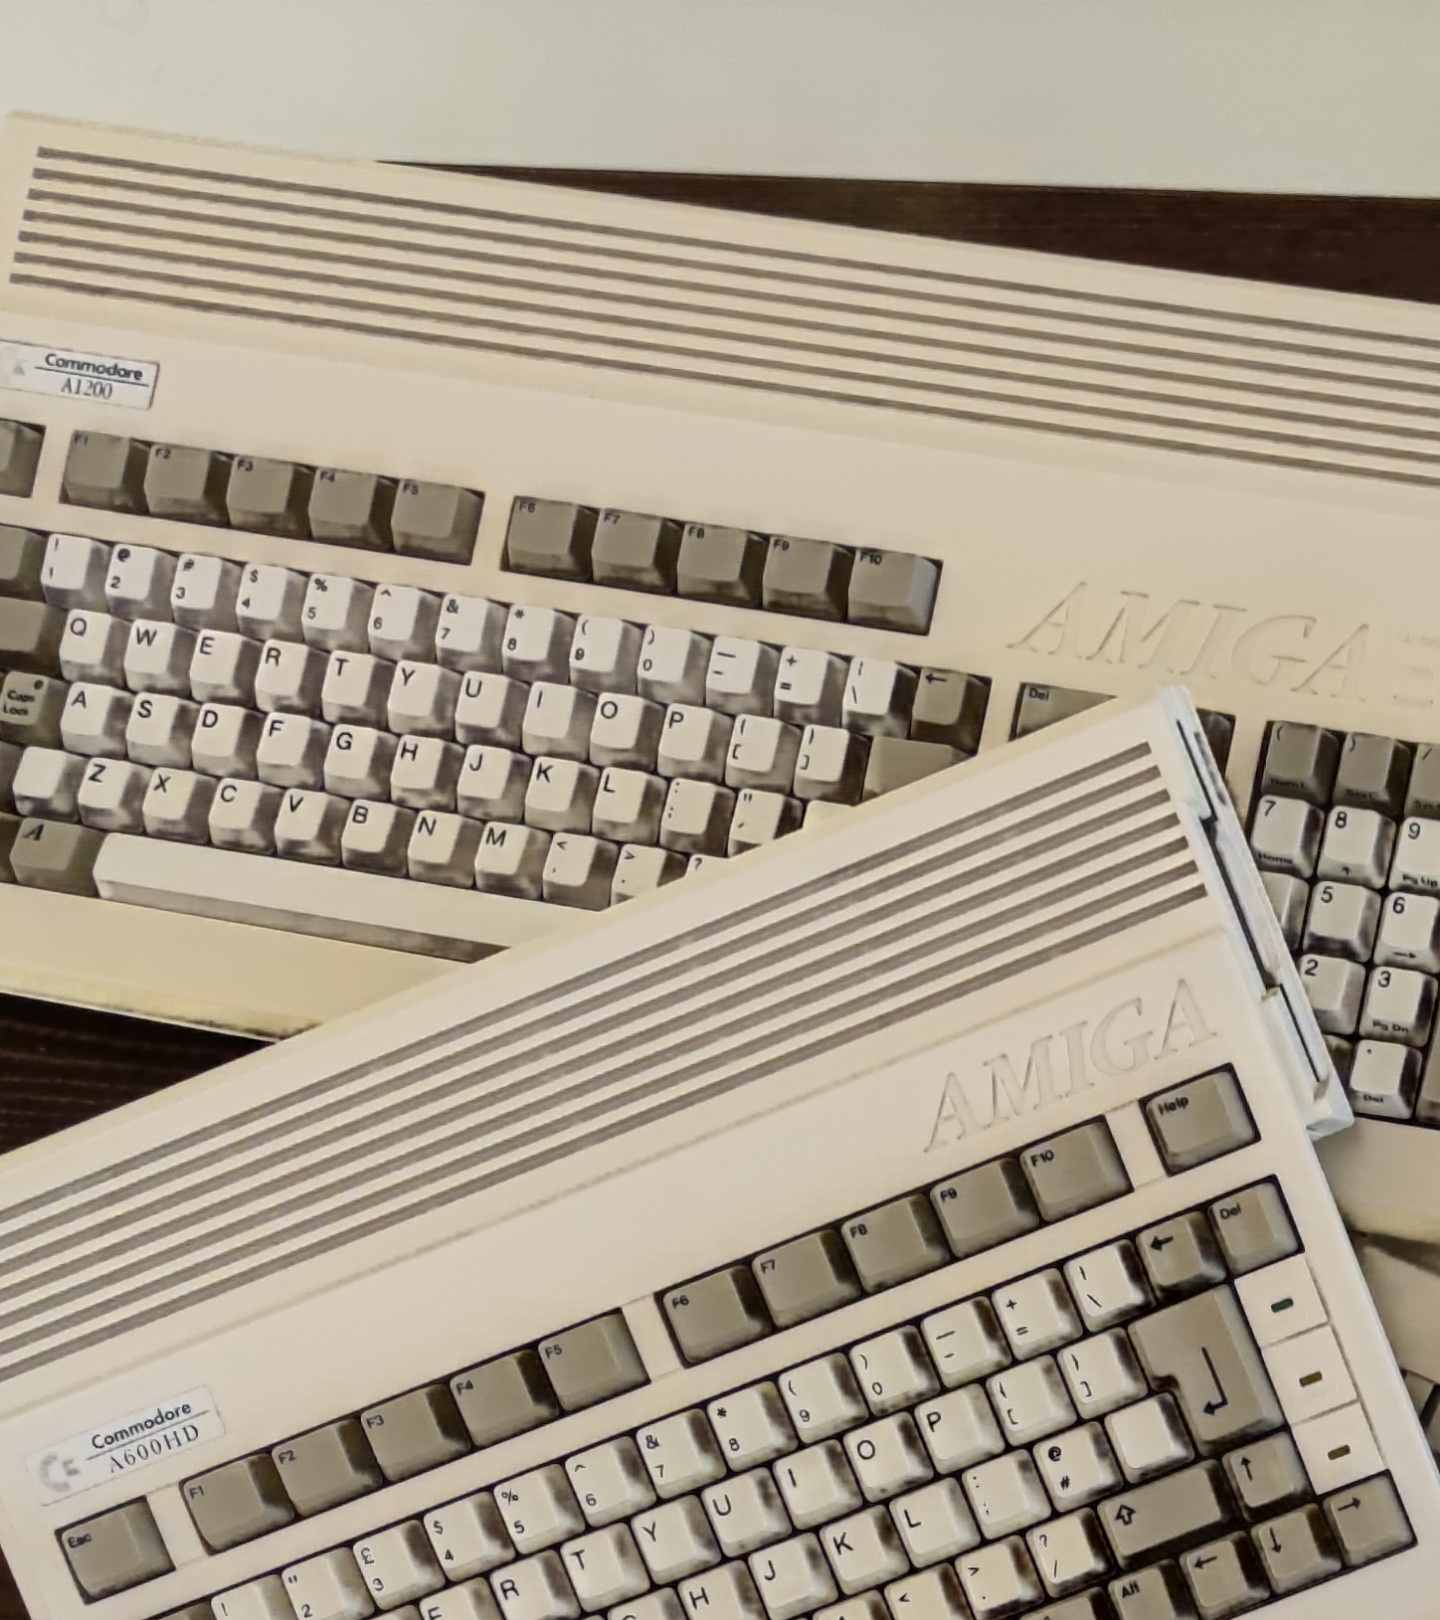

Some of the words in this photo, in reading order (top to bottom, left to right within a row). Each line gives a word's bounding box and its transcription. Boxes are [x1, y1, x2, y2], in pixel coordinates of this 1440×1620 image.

[45, 352, 143, 381] Commodore
[60, 378, 113, 399] A1200
[69, 617, 88, 637] Q
[136, 627, 158, 647] W
[199, 636, 215, 656] E
[1007, 582, 1369, 702] AMIGA
[265, 646, 282, 667] R
[335, 657, 349, 677] T
[401, 667, 416, 686] Y
[465, 678, 483, 698] U
[536, 690, 544, 709] I
[600, 700, 619, 720] O
[668, 710, 684, 729] P
[924, 978, 1217, 1153] AMIGA
[91, 1401, 192, 1449] Commodore
[926, 1411, 942, 1433] P
[108, 1424, 200, 1474] A600HD
[856, 1439, 876, 1461] O
[787, 1468, 797, 1488] I
[712, 1494, 732, 1517] U
[903, 1509, 922, 1529] L
[642, 1521, 657, 1542] Y
[832, 1532, 854, 1556] K
[570, 1549, 585, 1570] T
[764, 1559, 776, 1581] J
[499, 1579, 520, 1600] R
[688, 1586, 710, 1610] H
